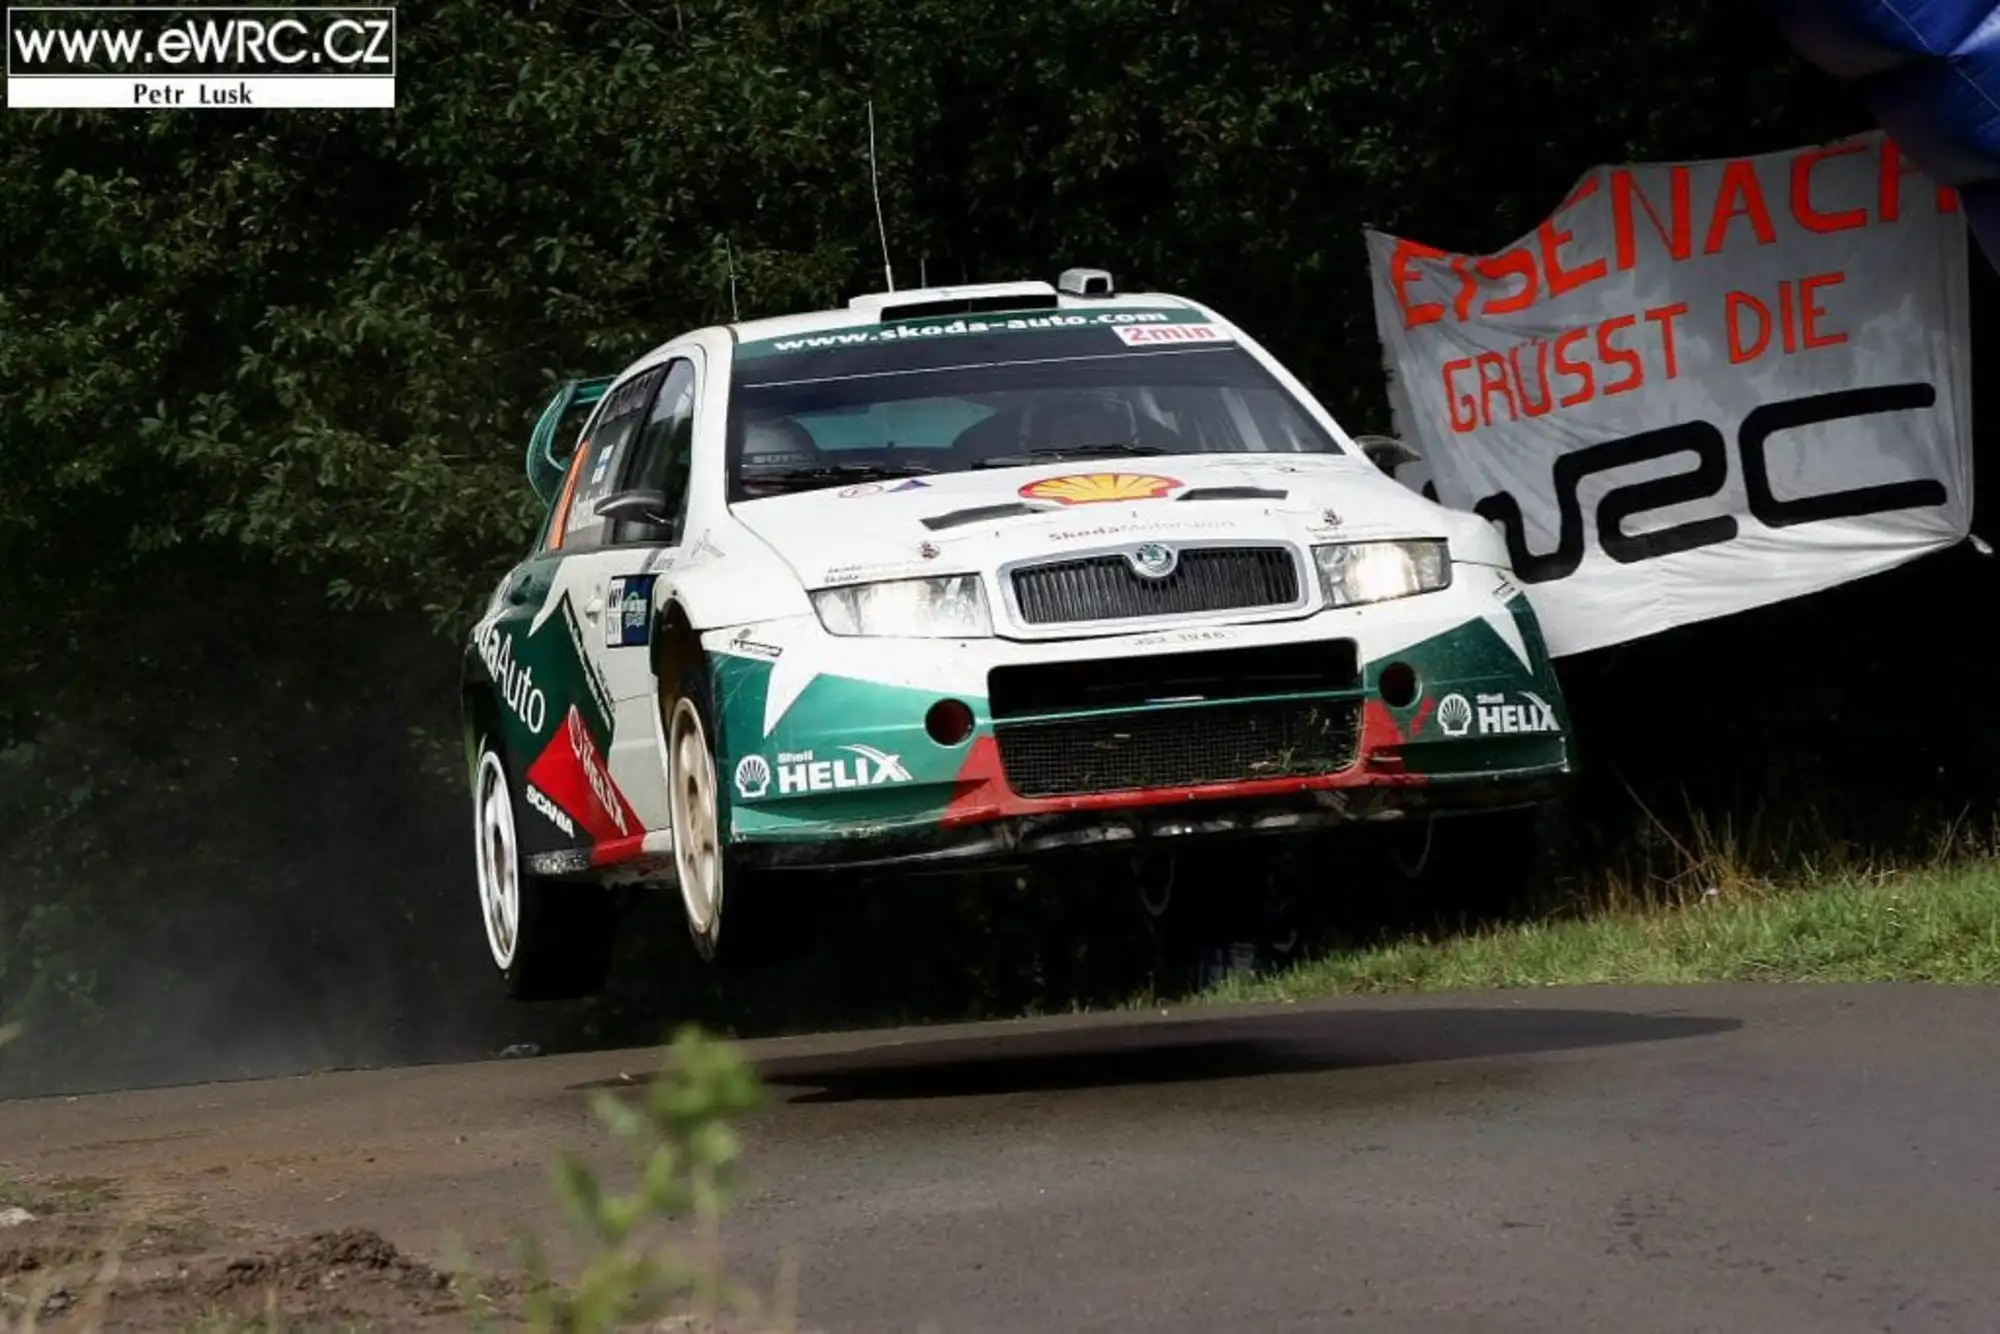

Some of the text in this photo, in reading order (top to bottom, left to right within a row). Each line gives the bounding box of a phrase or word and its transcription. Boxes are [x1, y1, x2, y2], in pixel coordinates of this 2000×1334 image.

[774, 312, 1169, 351] www.skoda-auto.com
[1123, 324, 1216, 342] 2min
[1724, 271, 1848, 364] DIE
[1477, 692, 1561, 734] HELIX
[777, 744, 912, 794] HELIX
